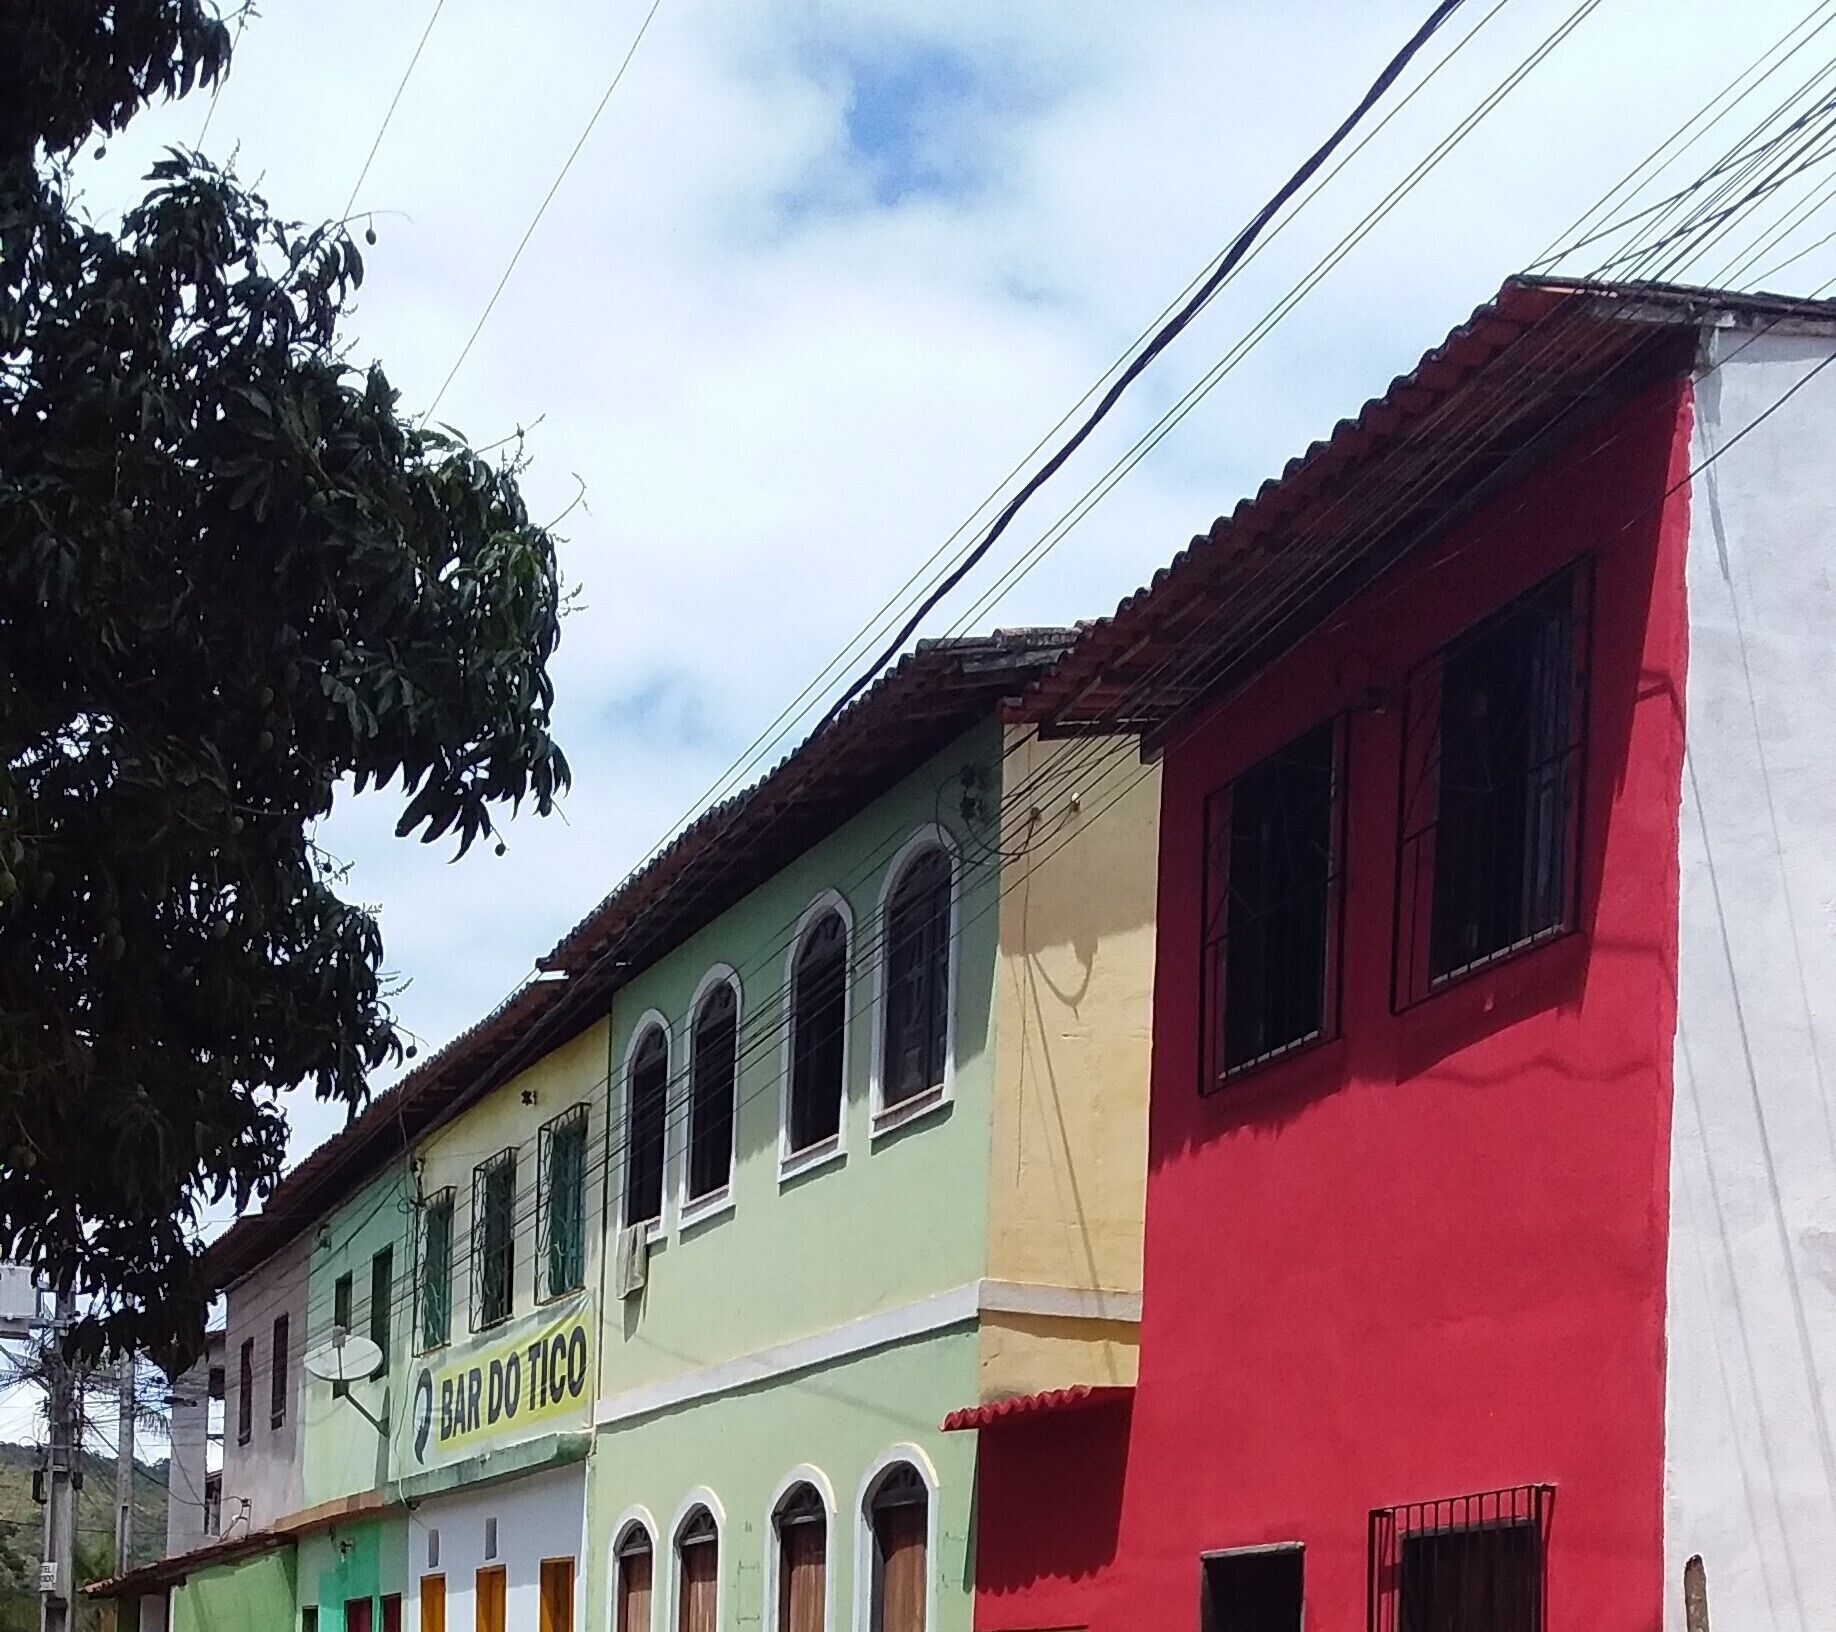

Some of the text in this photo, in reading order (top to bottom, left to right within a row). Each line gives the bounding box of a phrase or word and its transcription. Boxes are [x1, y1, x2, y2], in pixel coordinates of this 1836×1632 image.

[440, 1325, 587, 1441] BAR DO TICO
